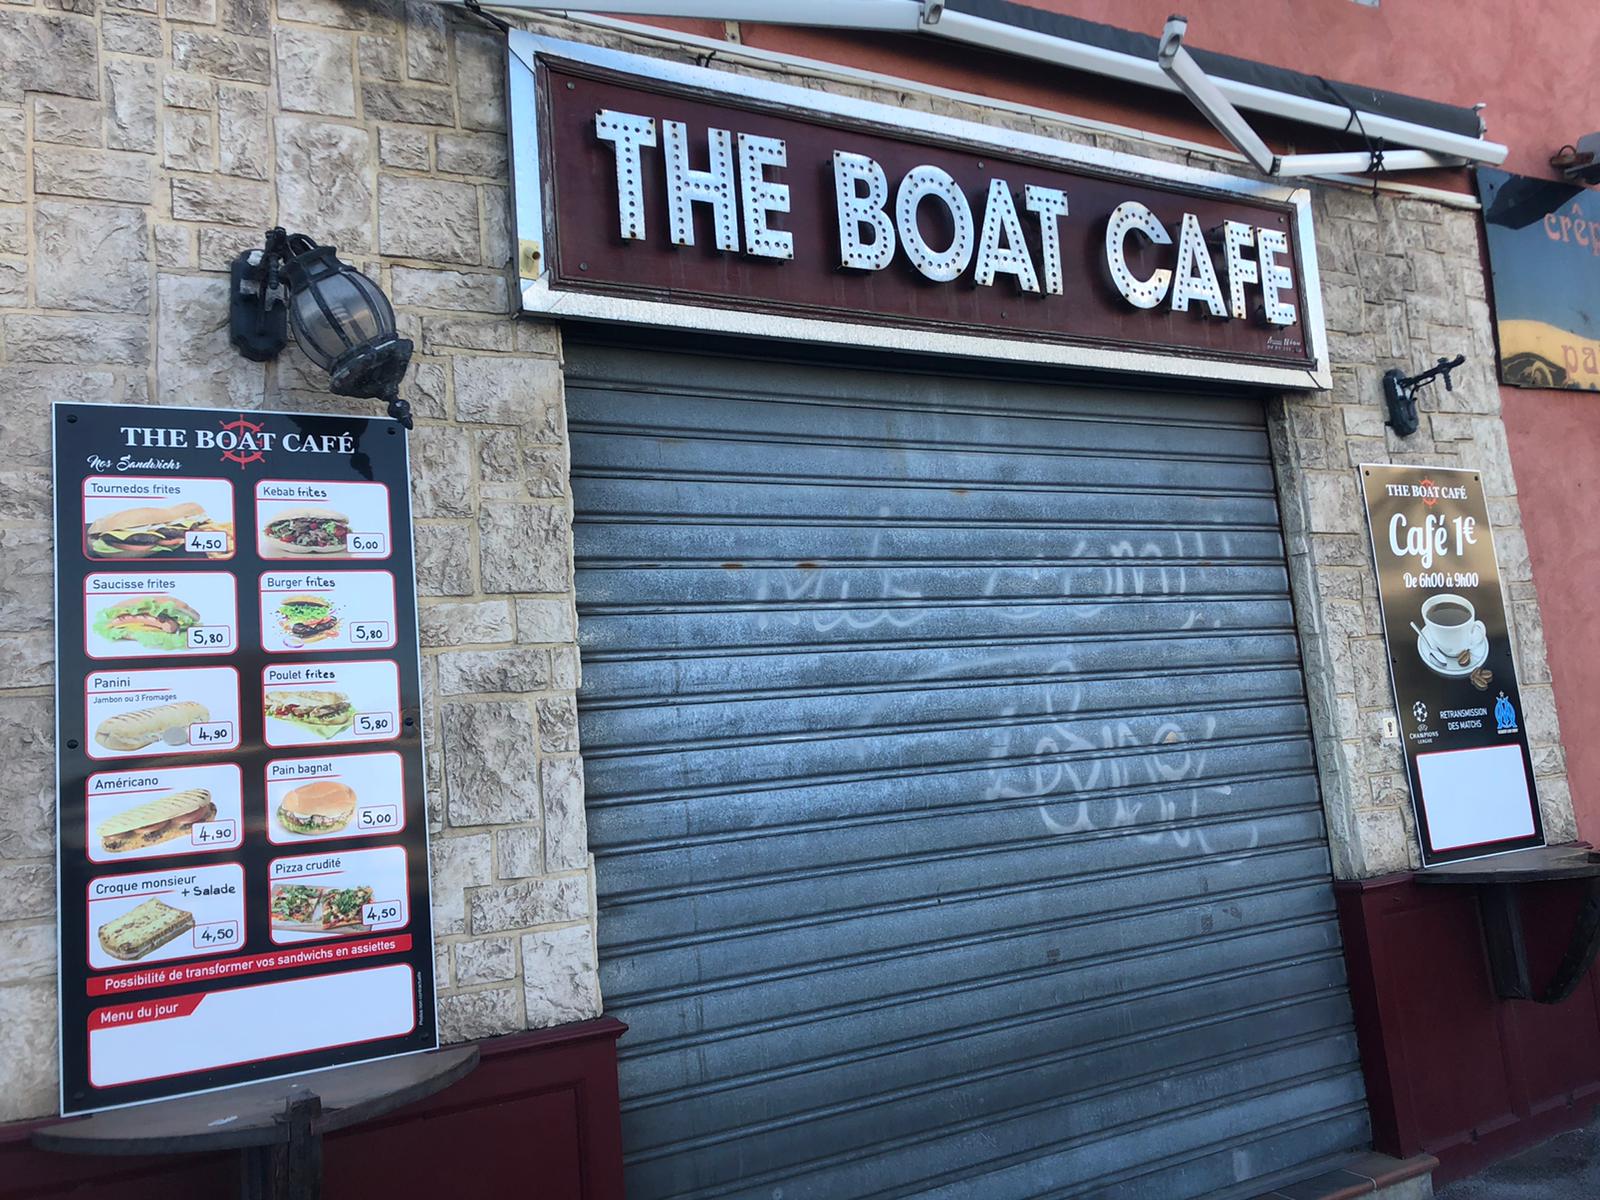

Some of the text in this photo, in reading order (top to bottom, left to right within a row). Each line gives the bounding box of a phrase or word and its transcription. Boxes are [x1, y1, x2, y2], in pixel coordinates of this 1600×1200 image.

[594, 108, 1298, 327] THE BOAT CAFE
[1561, 344, 1600, 384] pa
[120, 426, 355, 455] THE BOAT CAFÉ
[86, 454, 183, 472] Nos Sandwichs
[90, 482, 181, 496] Tournedos frites
[262, 485, 328, 499] Kebab frites
[1385, 483, 1468, 500] THE BOAT CAFÉ
[190, 535, 222, 551] 4,50
[352, 536, 379, 551] 6,00
[1388, 512, 1477, 570] Café 1€
[92, 578, 176, 591] Saucisse frites
[266, 575, 336, 591] Burger frites
[1403, 571, 1480, 589] De 6h00 à 9h00
[192, 629, 224, 645] 5,80
[355, 625, 384, 641] 5,80
[94, 676, 131, 689] Panini
[268, 669, 336, 682] Poulet frites
[92, 695, 123, 705] Jambon
[135, 694, 141, 703] 3
[141, 692, 178, 704] Fromages
[1440, 707, 1488, 719] RETRANSMISSION
[360, 715, 389, 732] 5,80
[1447, 719, 1482, 731] DES MATCHS
[198, 726, 228, 742] 4,90
[1409, 730, 1439, 740] CHAMPIONS
[271, 762, 333, 778] Pain bagnat
[94, 774, 160, 791] Américano
[361, 809, 393, 825] 5,00
[198, 825, 232, 842] 4,90
[274, 857, 342, 875] Pizza crudité
[95, 873, 197, 899] Croque monsieur
[192, 883, 237, 898] Salade
[365, 905, 398, 922] 4,50
[200, 926, 235, 943] 4,50
[104, 939, 397, 991] Possibilité de transformer vos sandwichs en assiettes
[99, 1003, 179, 1025] Menu du jour
